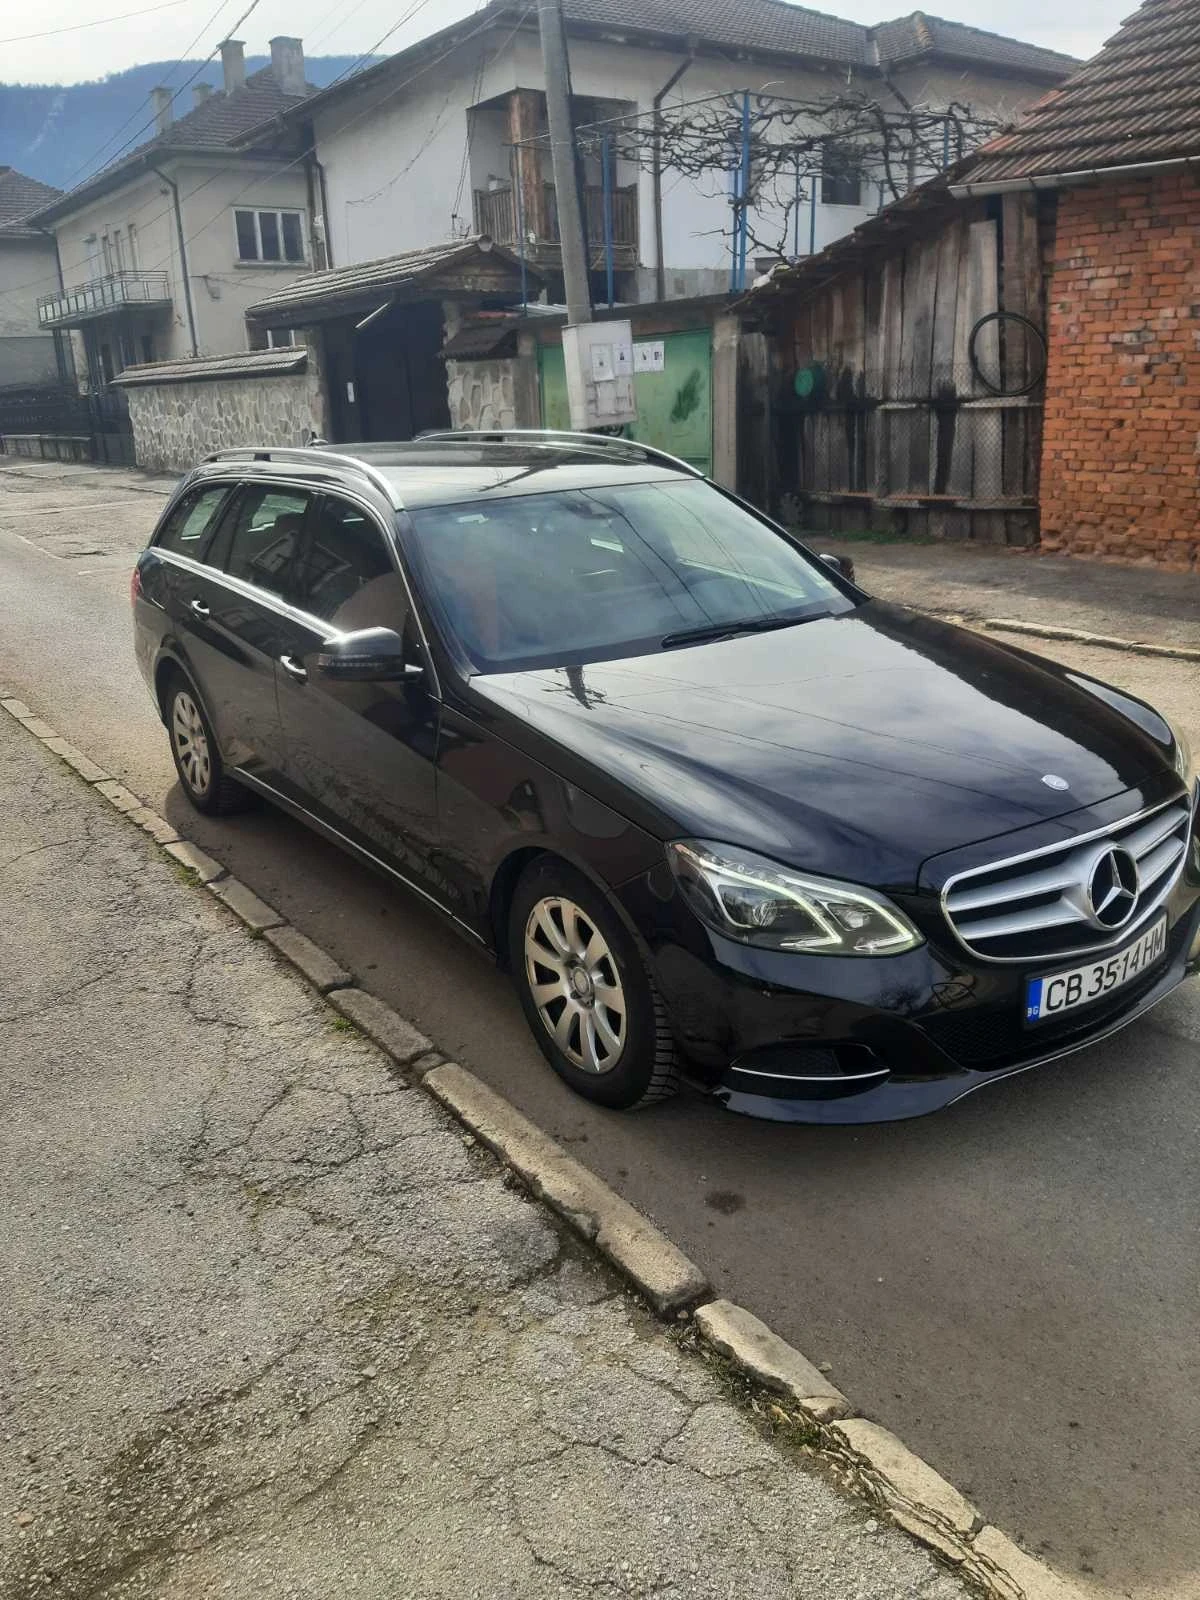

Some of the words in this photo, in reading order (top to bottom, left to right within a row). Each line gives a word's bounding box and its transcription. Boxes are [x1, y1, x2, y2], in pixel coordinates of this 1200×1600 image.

[1046, 973, 1083, 1011] CB
[1087, 942, 1140, 997] 3514
[1142, 923, 1164, 965] HM
[1027, 1007, 1039, 1017] BG
